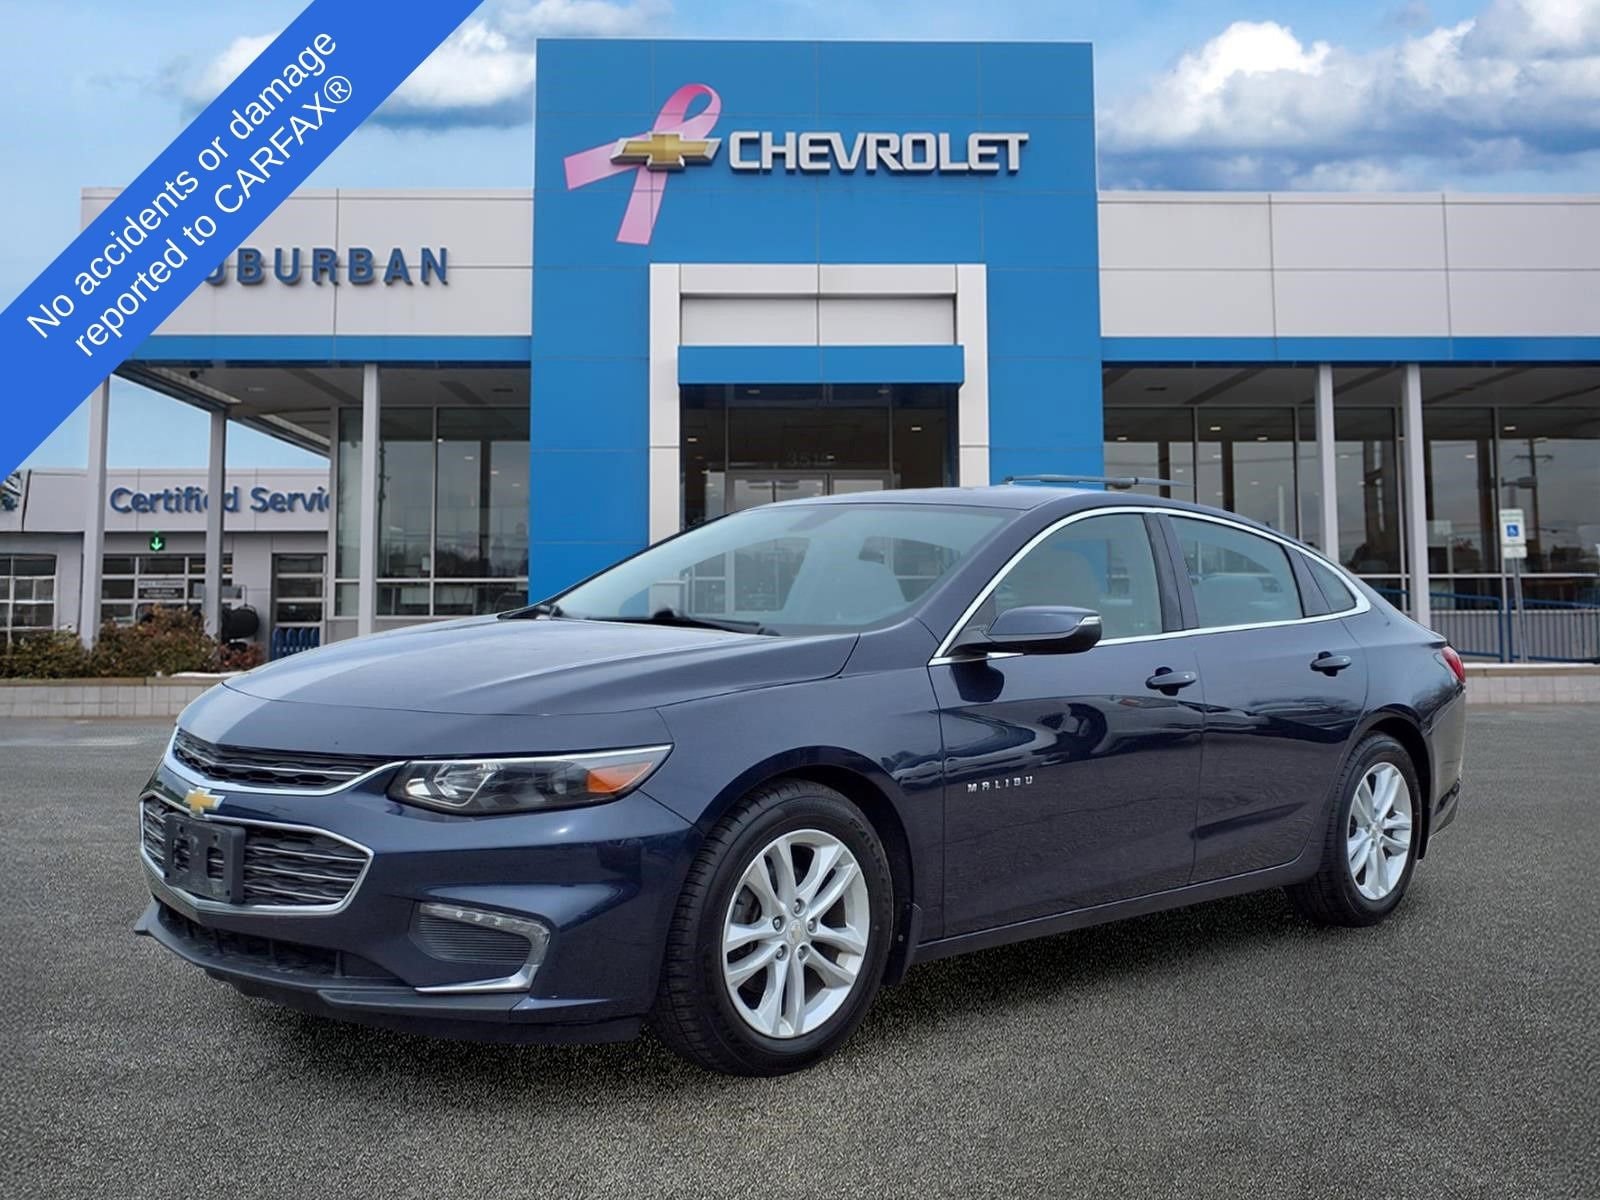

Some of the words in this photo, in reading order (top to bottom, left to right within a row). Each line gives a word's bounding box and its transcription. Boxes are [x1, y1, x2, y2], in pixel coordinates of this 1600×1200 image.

[729, 131, 1029, 172] CHEVROLET
[110, 486, 240, 513] Certifid
[967, 776, 1034, 793] MALIBU
